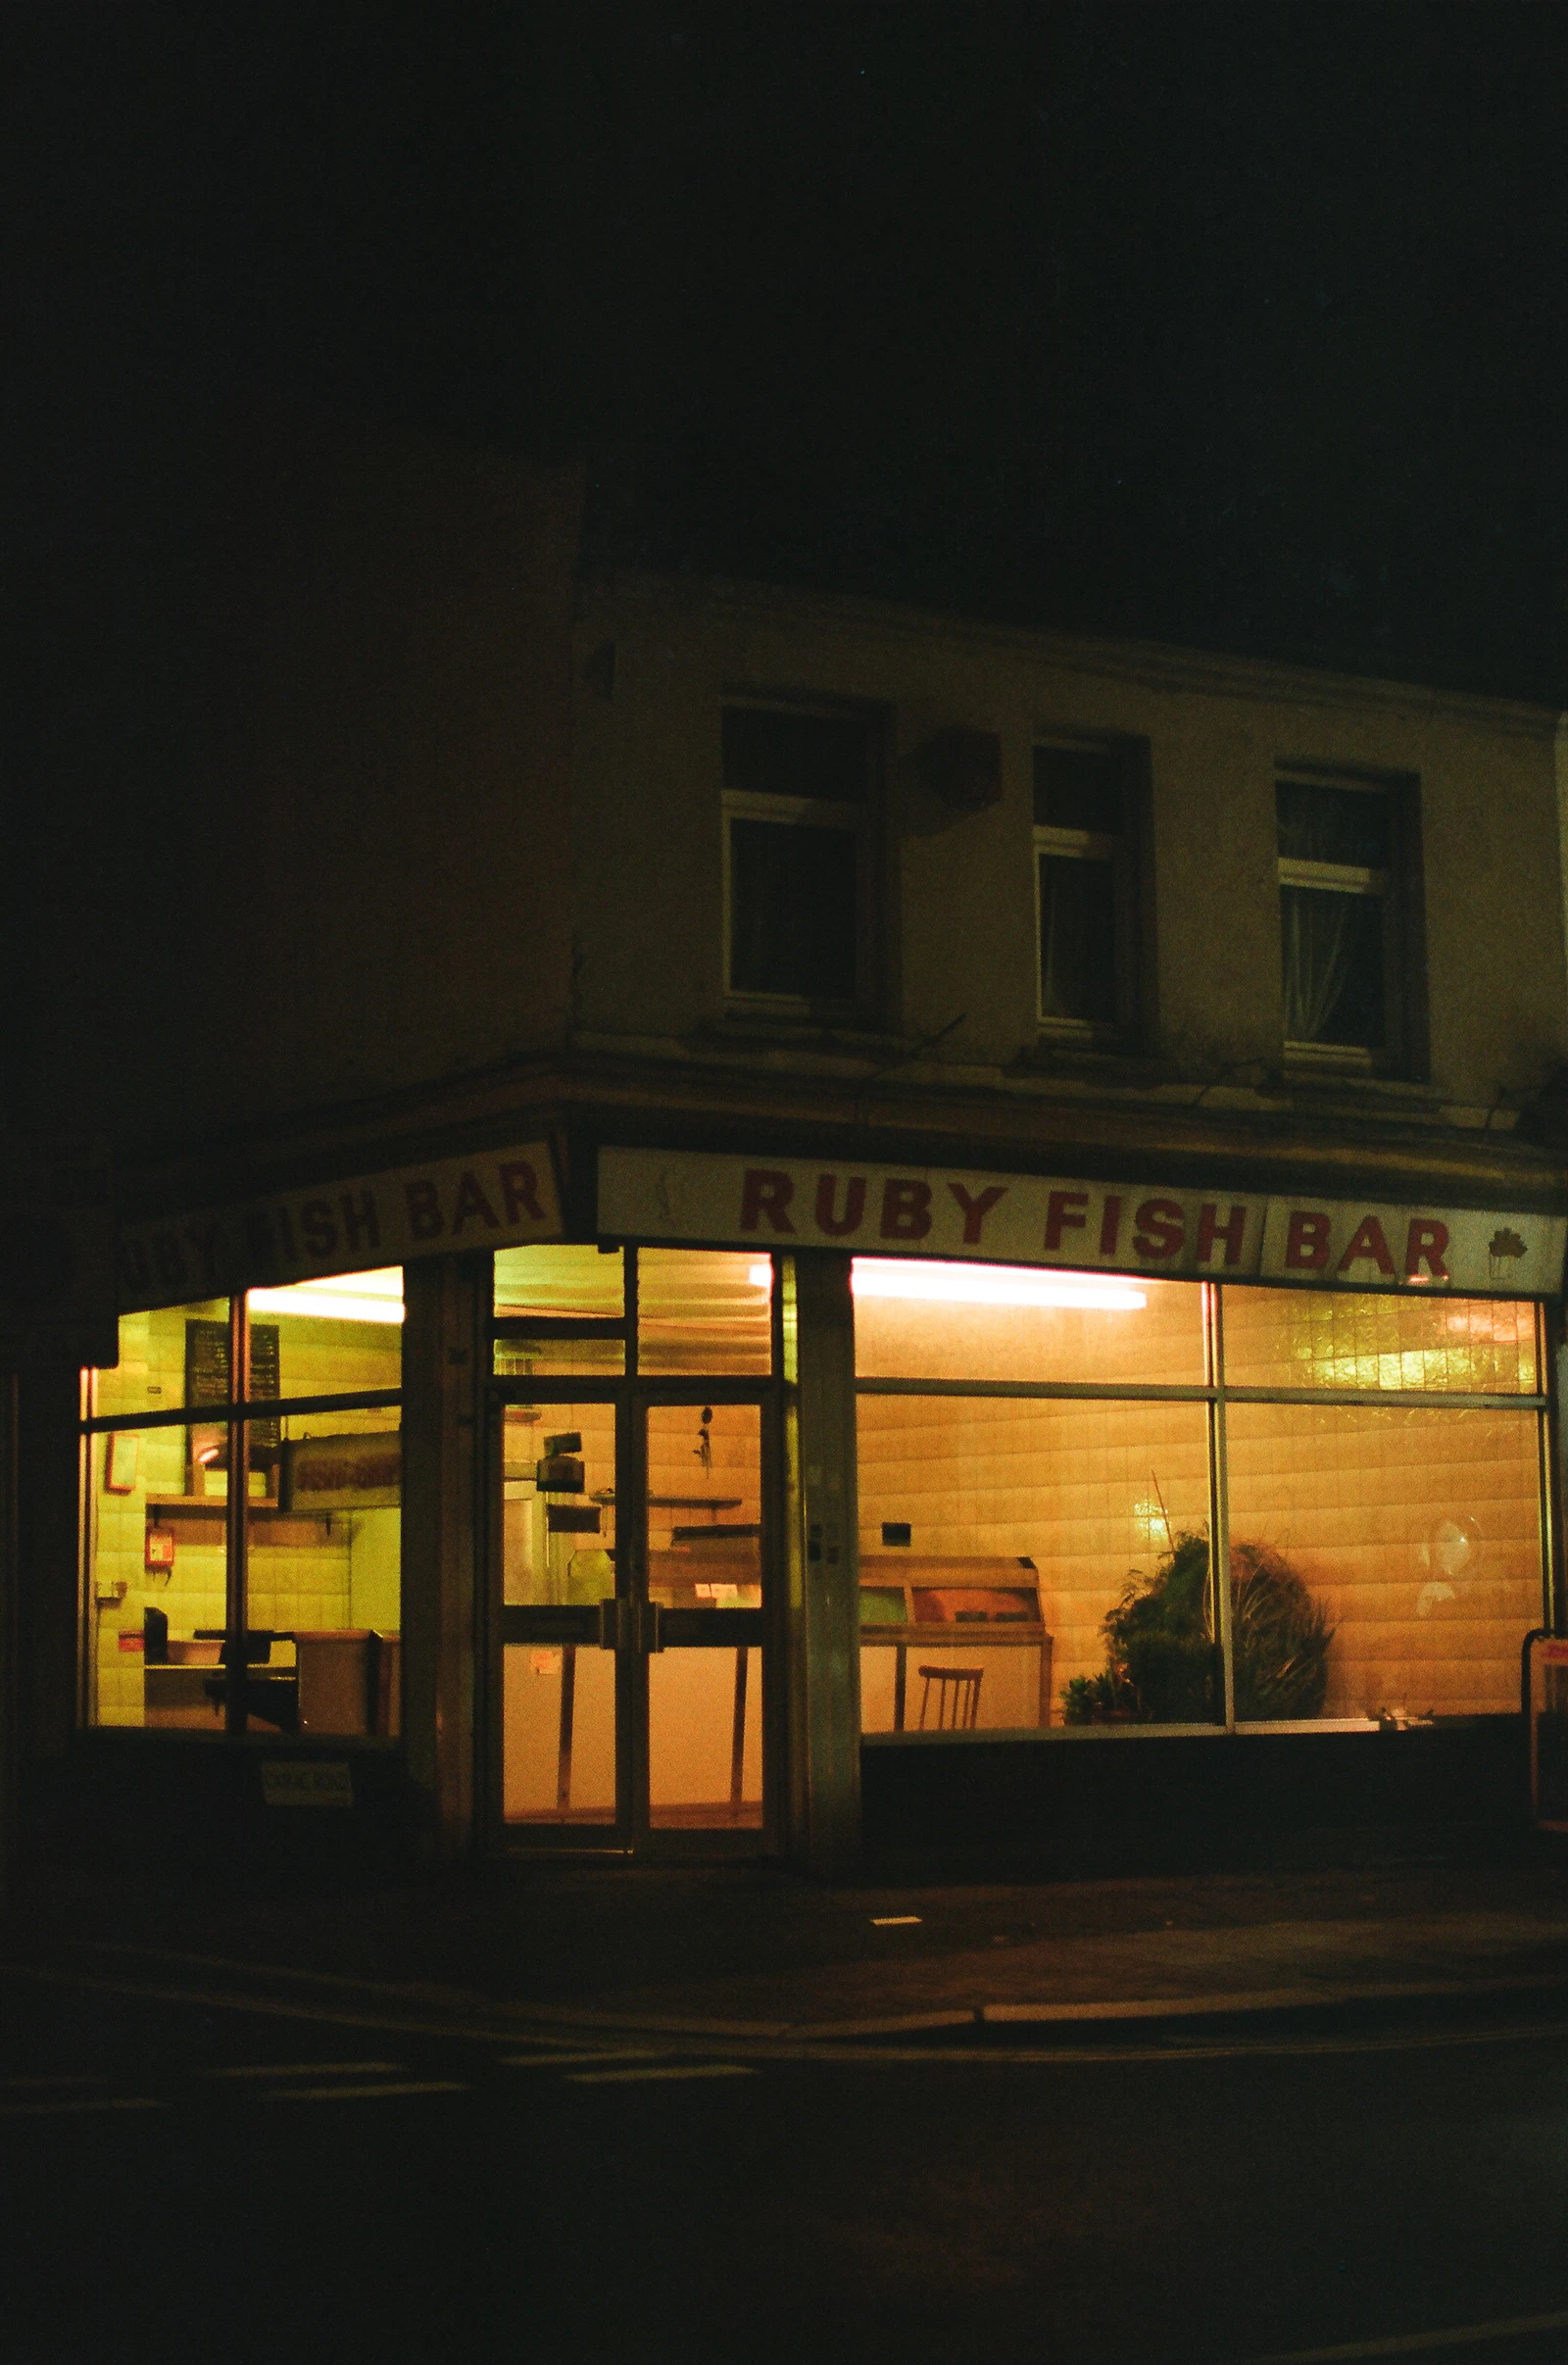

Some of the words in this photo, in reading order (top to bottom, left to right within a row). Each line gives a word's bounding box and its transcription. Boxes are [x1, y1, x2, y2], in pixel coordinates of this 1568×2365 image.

[121, 1221, 220, 1294] UBY
[404, 1160, 547, 1243] BAR
[740, 1168, 1008, 1246] RUBY
[1044, 1191, 1247, 1265] FISH
[1285, 1191, 1449, 1284] BAR
